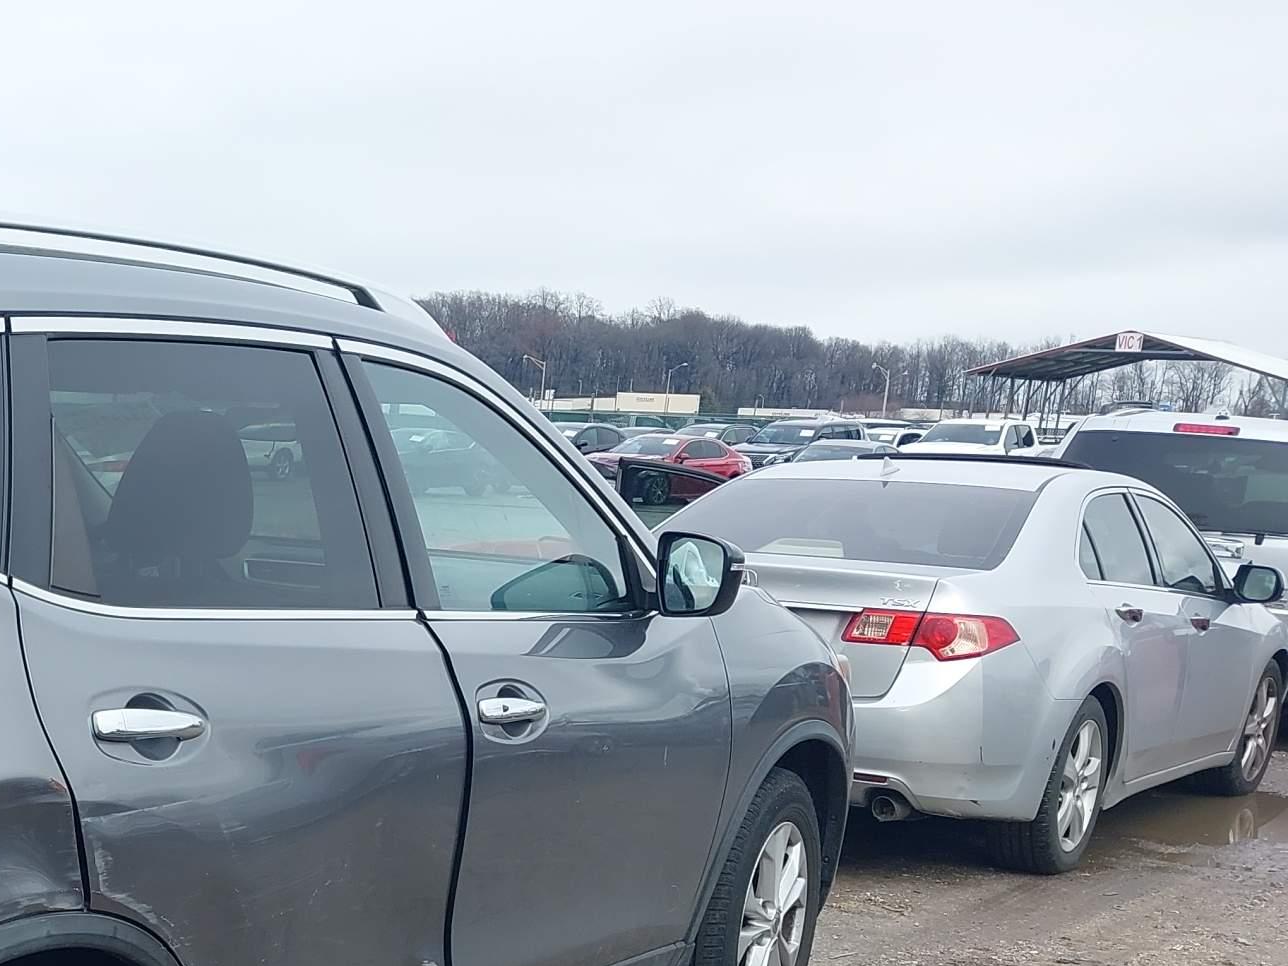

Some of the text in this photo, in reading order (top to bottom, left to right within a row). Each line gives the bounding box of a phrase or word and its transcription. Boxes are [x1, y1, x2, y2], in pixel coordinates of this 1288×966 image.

[1118, 335, 1143, 350] VIC 1
[880, 597, 921, 609] TSX
